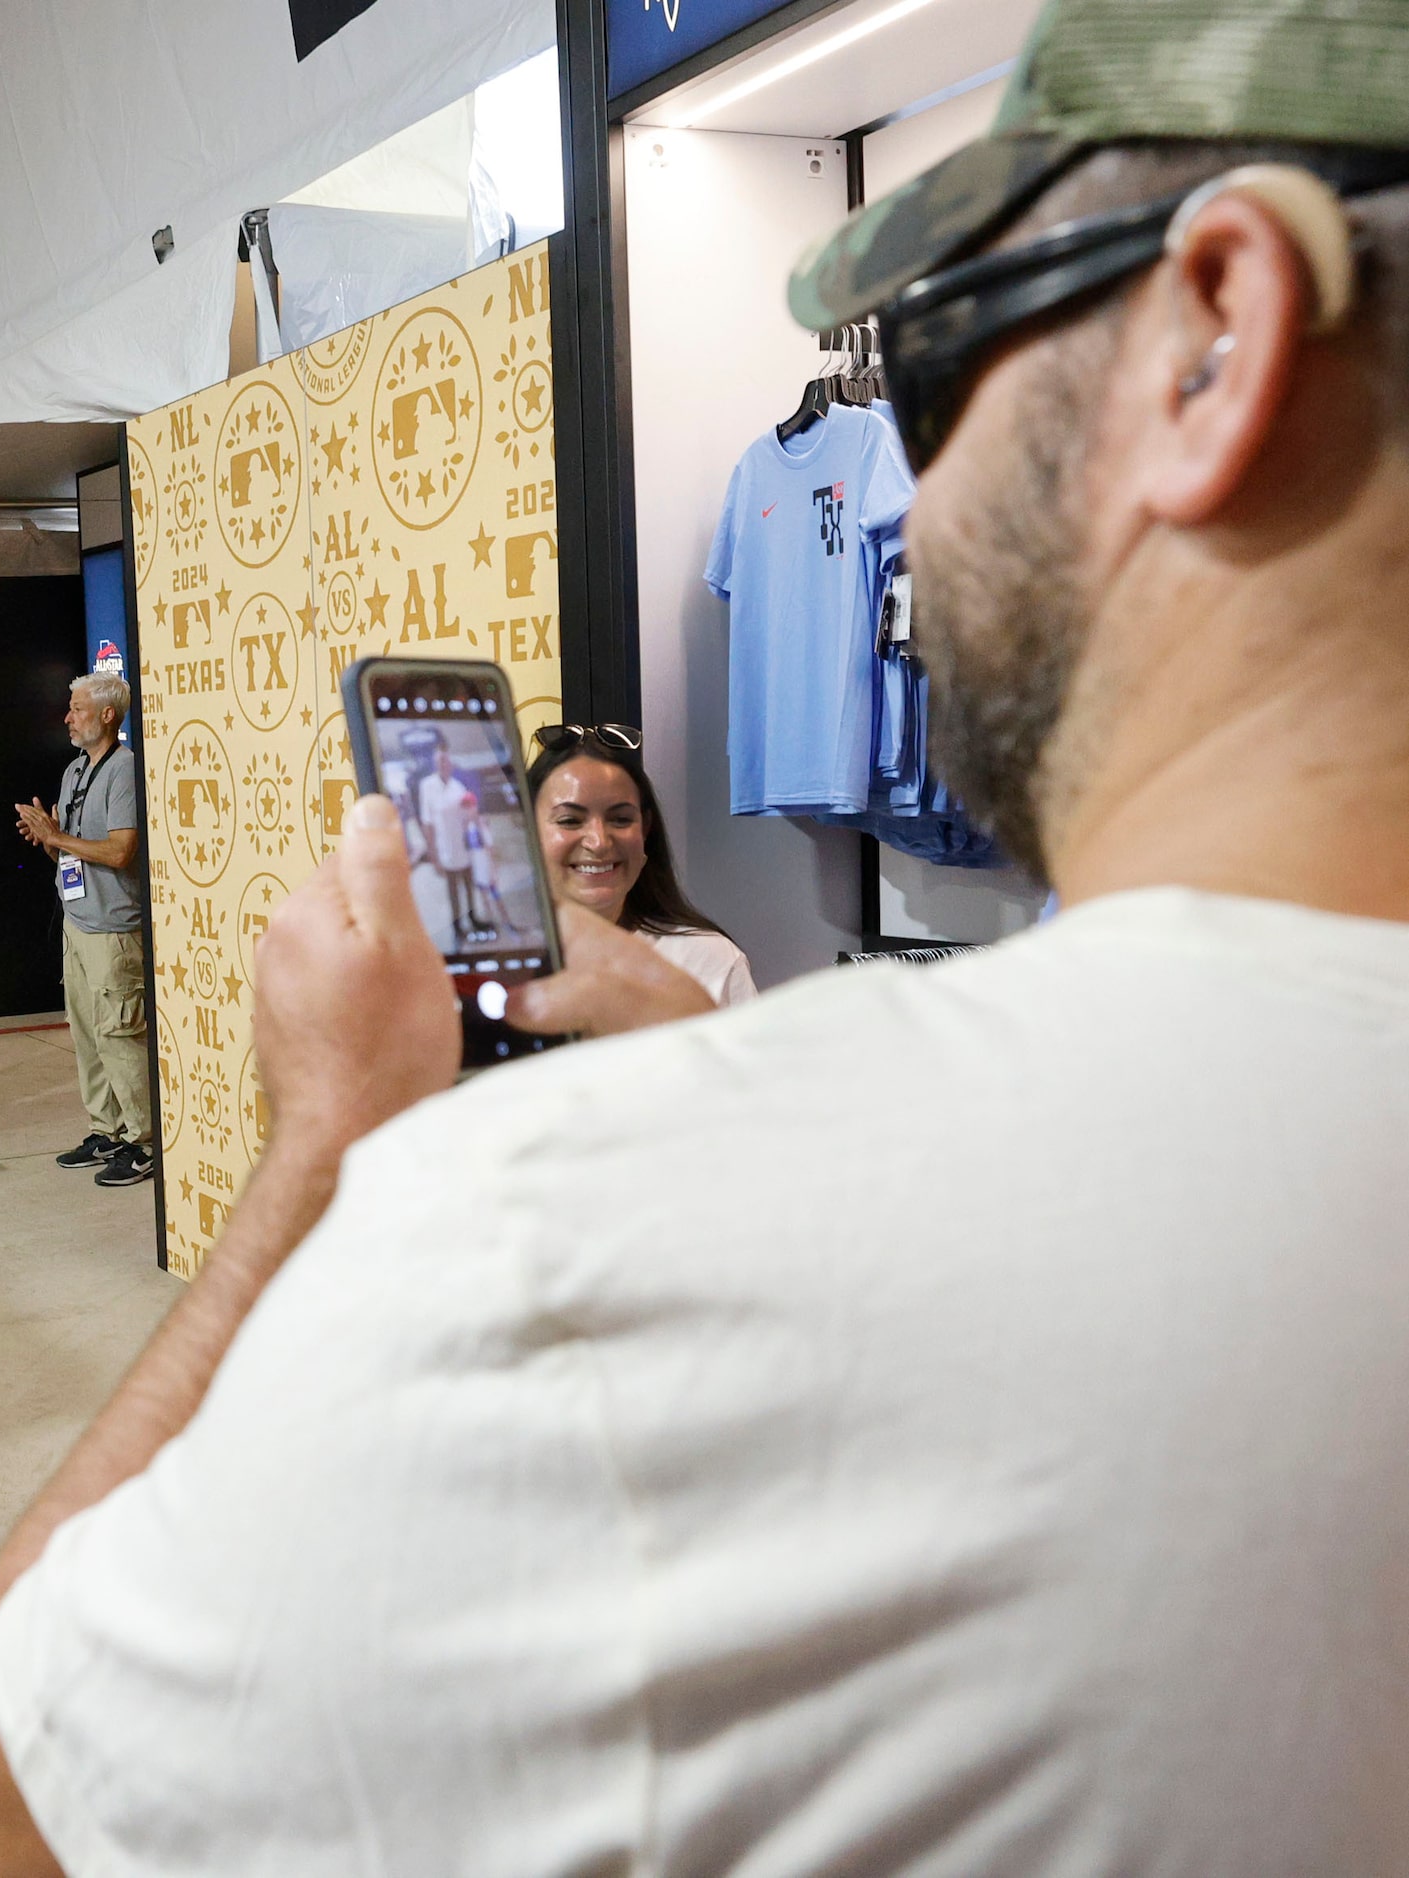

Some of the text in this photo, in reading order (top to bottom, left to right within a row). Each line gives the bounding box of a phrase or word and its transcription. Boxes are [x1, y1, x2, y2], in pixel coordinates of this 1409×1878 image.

[170, 404, 199, 452] NL
[324, 510, 359, 563] AL
[172, 562, 208, 593] 2024
[331, 589, 352, 618] VS
[399, 563, 460, 643] AL
[239, 631, 288, 692] TX
[488, 614, 560, 664] TEX
[165, 658, 225, 695] TEXAS
[329, 644, 357, 693] N
[192, 897, 219, 940] AL
[196, 961, 213, 986] VS
[195, 1005, 224, 1051] NL
[198, 1160, 234, 1195] 2024
